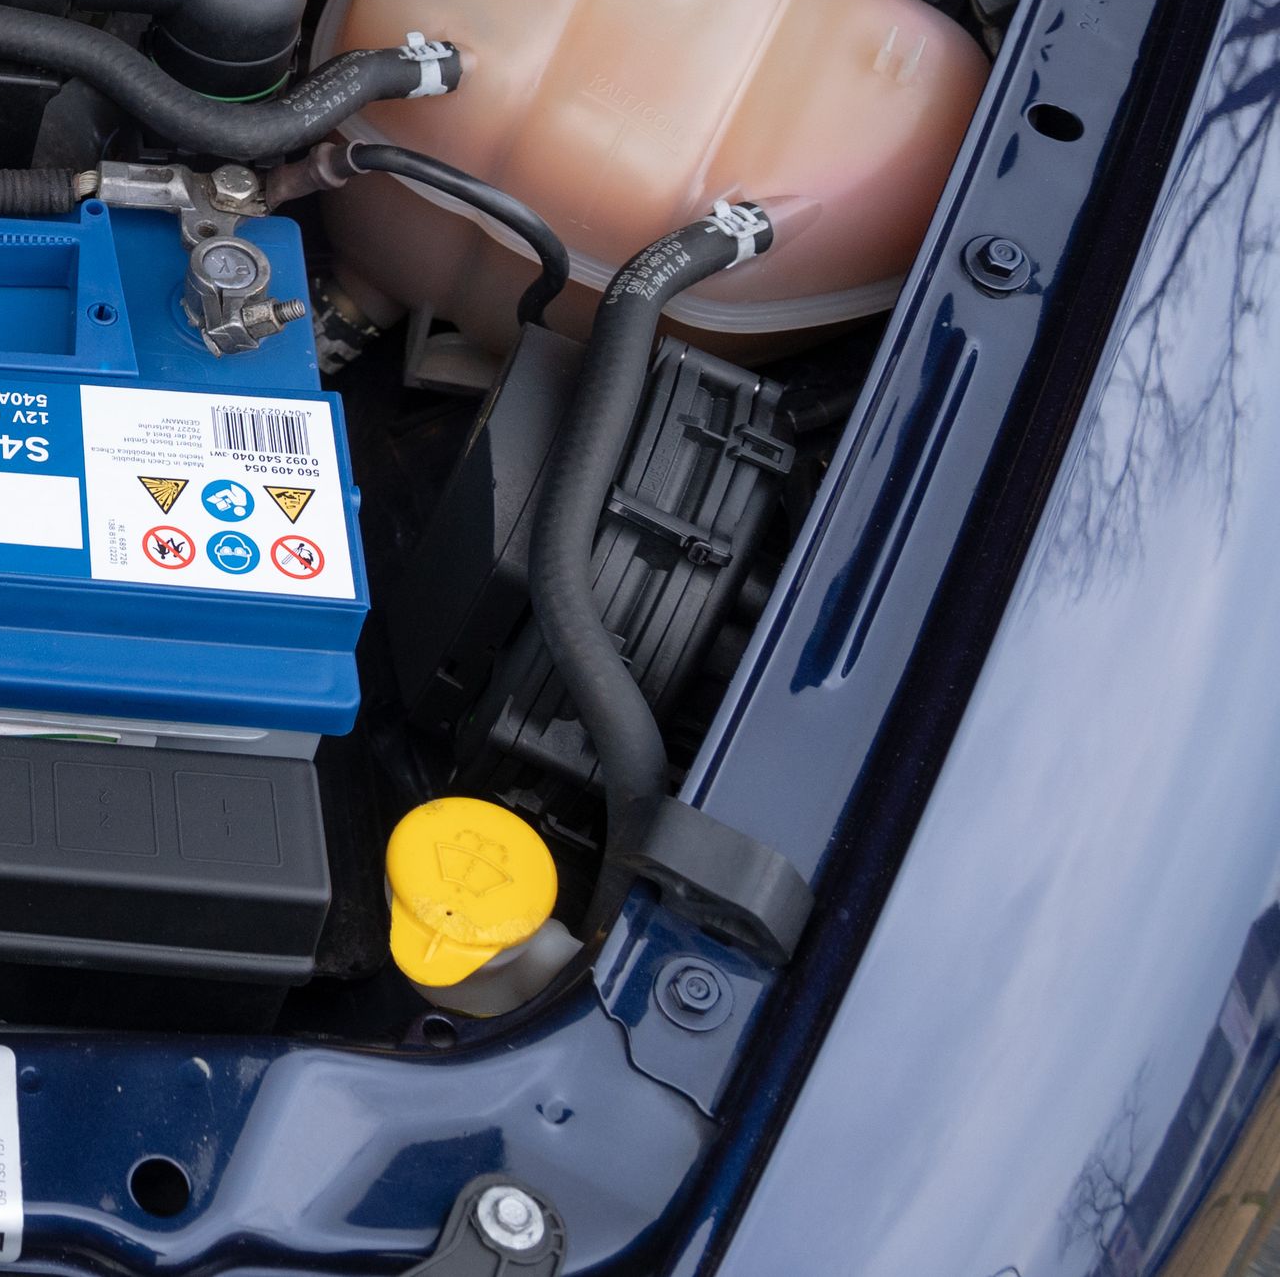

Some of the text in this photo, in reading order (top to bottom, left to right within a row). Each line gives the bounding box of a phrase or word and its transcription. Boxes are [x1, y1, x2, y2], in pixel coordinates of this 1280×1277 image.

[625, 236, 682, 296] GM 90 499 810
[12, 409, 49, 424] 12V
[160, 417, 200, 425] GERMANY
[137, 422, 174, 431] Karlsruhe
[111, 454, 145, 463] Republic
[147, 457, 171, 465] Czech
[182, 459, 204, 467] Made
[231, 452, 318, 465] 0 092 S40 040
[244, 463, 319, 476] 560 409 054
